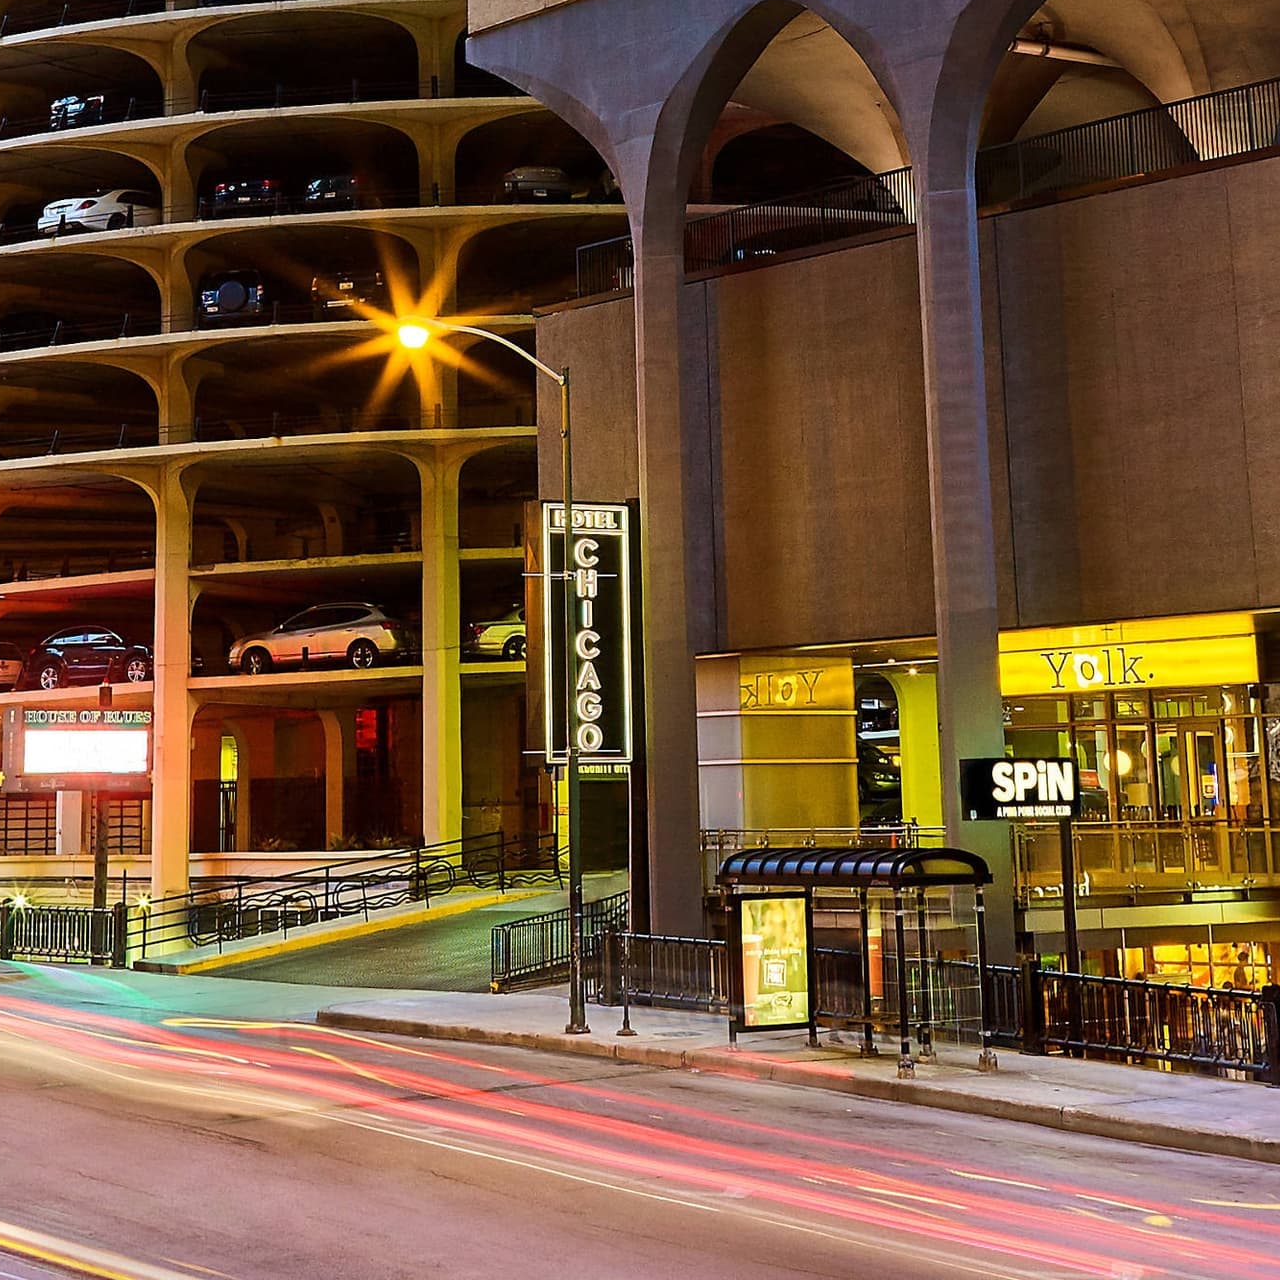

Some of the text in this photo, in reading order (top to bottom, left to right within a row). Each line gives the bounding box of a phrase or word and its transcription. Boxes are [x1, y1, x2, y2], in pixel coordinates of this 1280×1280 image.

[554, 510, 618, 528] HOTEL
[574, 538, 604, 752] CHICAGO
[24, 710, 76, 723] HOUSE
[79, 710, 100, 723] OF
[104, 710, 152, 723] BLUES
